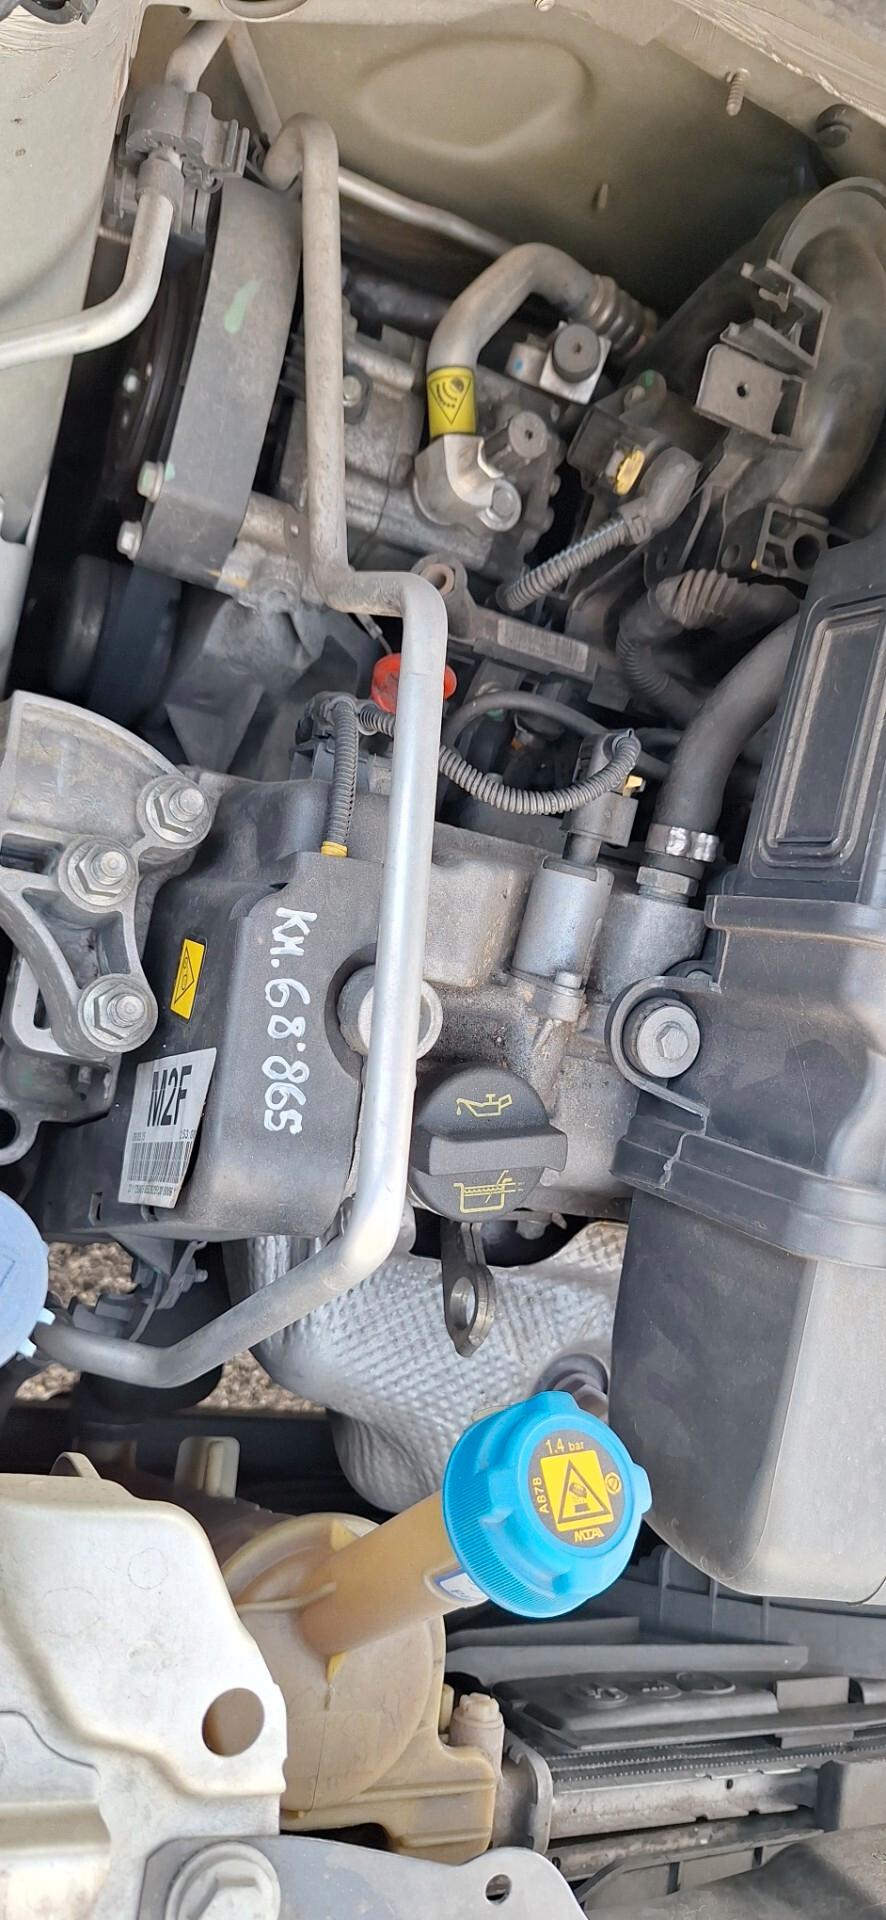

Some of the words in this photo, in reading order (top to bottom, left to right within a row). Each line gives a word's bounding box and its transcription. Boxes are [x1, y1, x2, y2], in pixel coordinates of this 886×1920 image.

[147, 1064, 192, 1127] M2F
[545, 1438, 565, 1454] 1.4
[568, 1441, 584, 1451] bar
